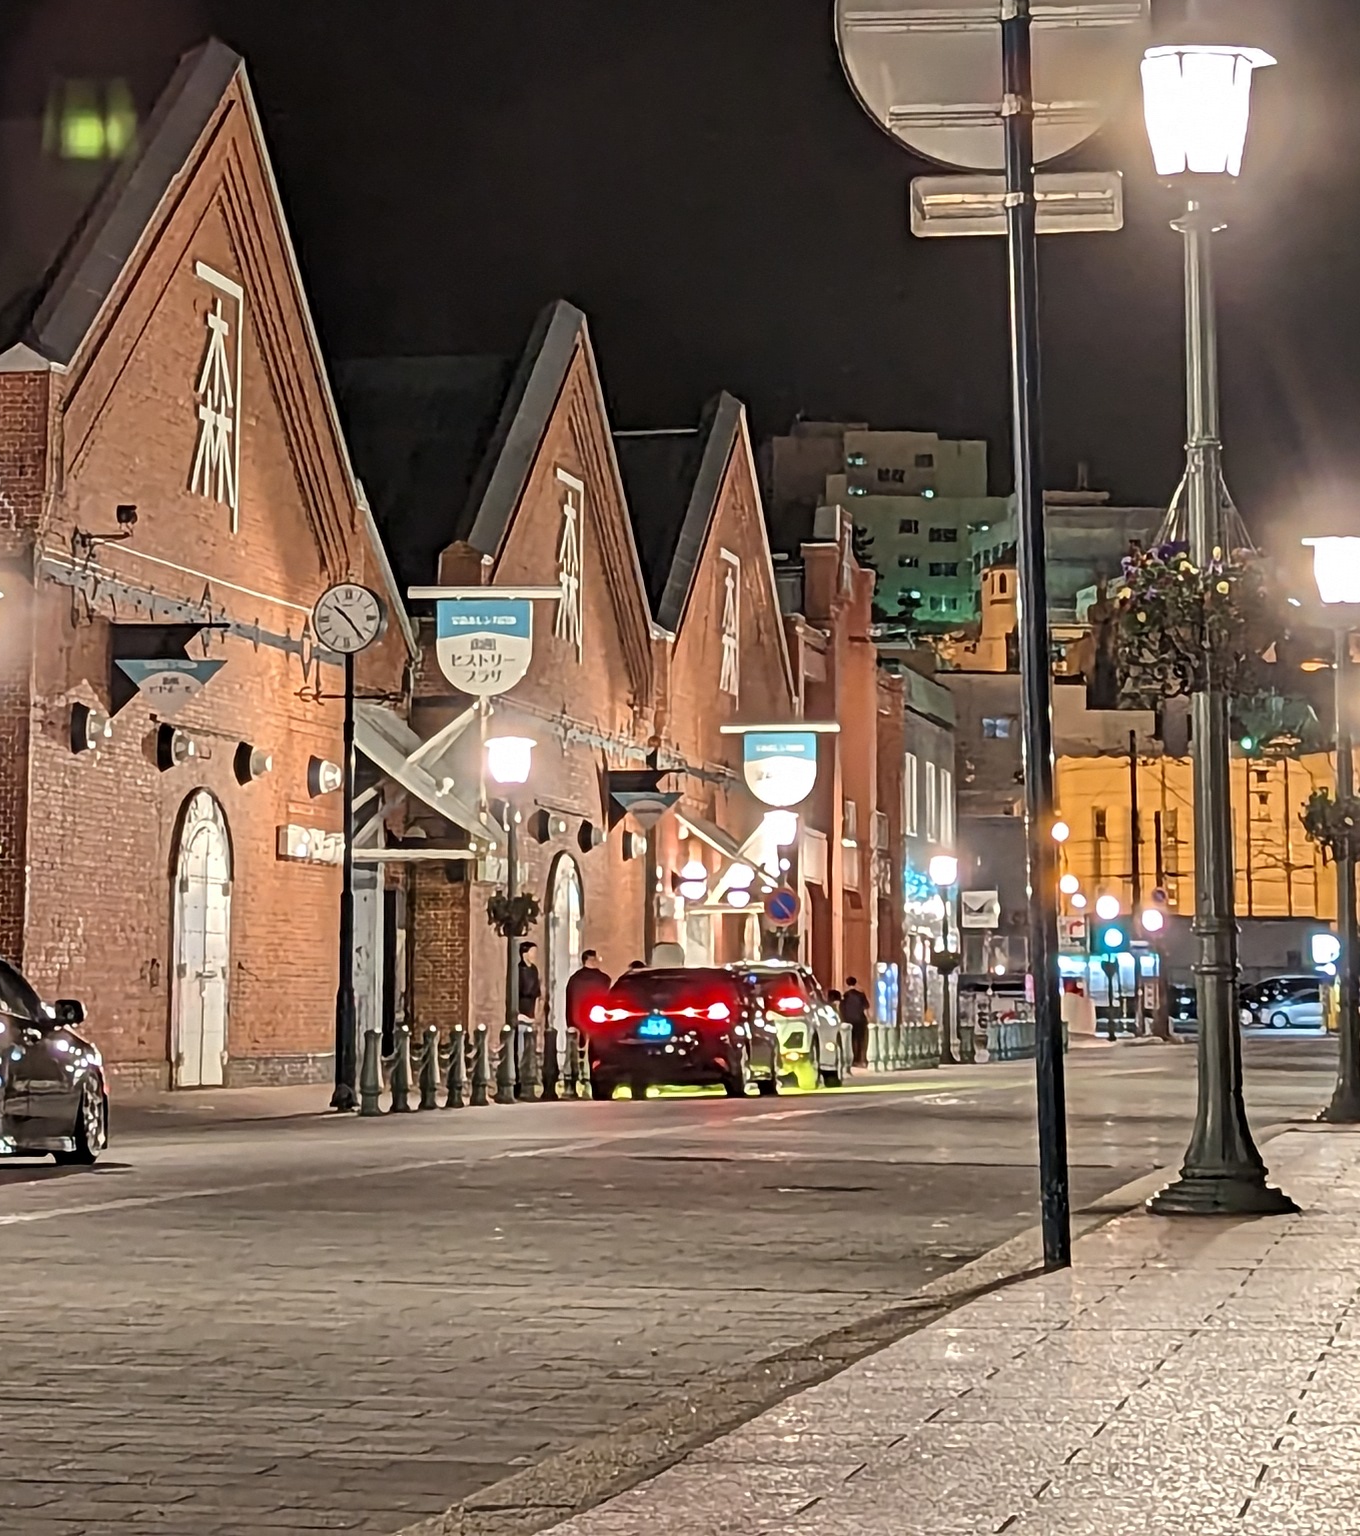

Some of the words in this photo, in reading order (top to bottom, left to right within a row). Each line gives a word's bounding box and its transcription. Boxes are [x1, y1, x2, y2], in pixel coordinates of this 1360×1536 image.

[451, 653, 516, 667] ヒストリー
